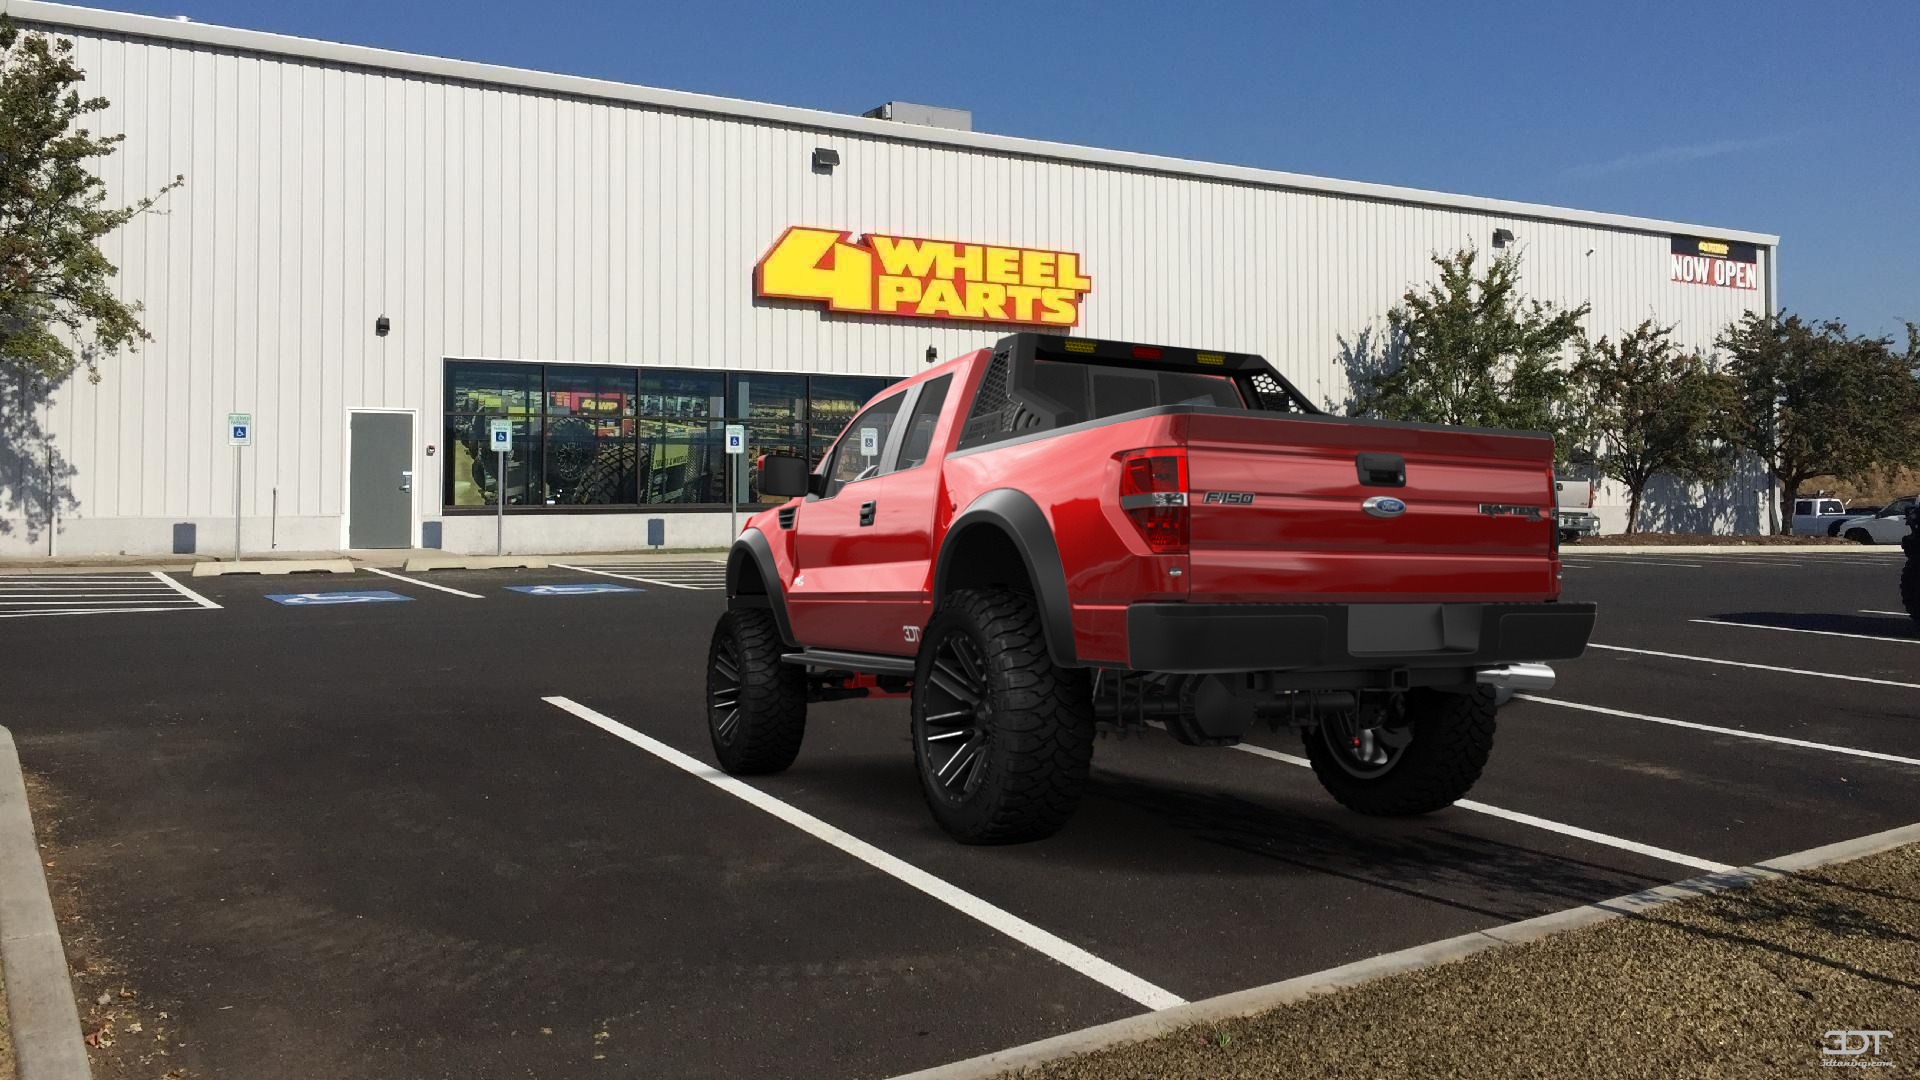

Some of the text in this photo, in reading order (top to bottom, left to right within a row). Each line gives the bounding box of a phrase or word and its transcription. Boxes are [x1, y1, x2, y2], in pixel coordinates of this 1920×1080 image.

[763, 228, 1090, 311] 4 WHEEL
[1671, 254, 1757, 289] NOW OPEN
[878, 274, 1077, 324] PARTS
[1381, 501, 1400, 511] Ford
